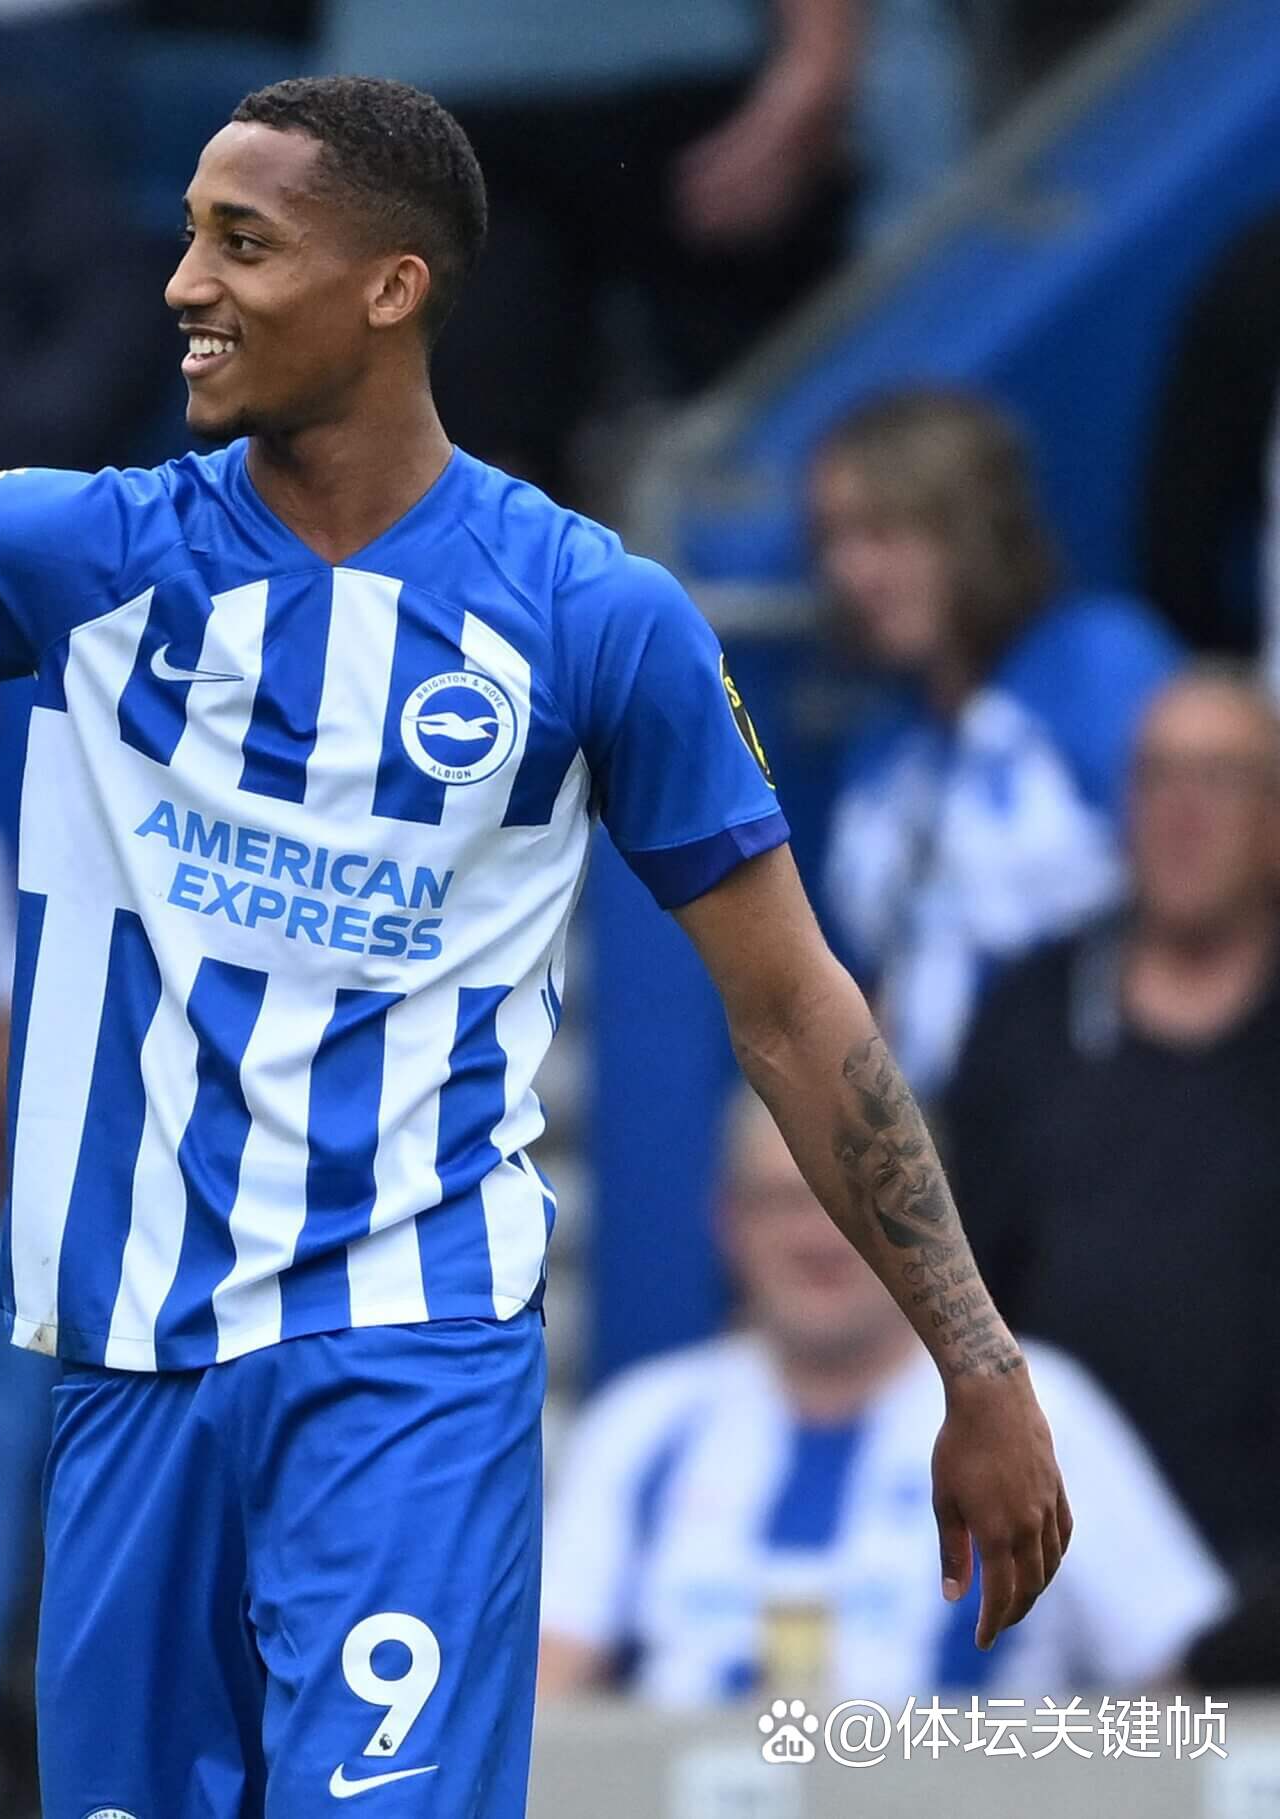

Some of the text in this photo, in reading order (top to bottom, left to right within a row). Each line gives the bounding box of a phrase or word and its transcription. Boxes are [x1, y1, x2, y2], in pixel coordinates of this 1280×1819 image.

[416, 675, 506, 709] BRIGHTON & HOVE
[430, 765, 472, 779] ALBION
[133, 800, 455, 909] AMERICAN
[167, 862, 443, 961] EXPRESS
[341, 1611, 441, 1757] 9
